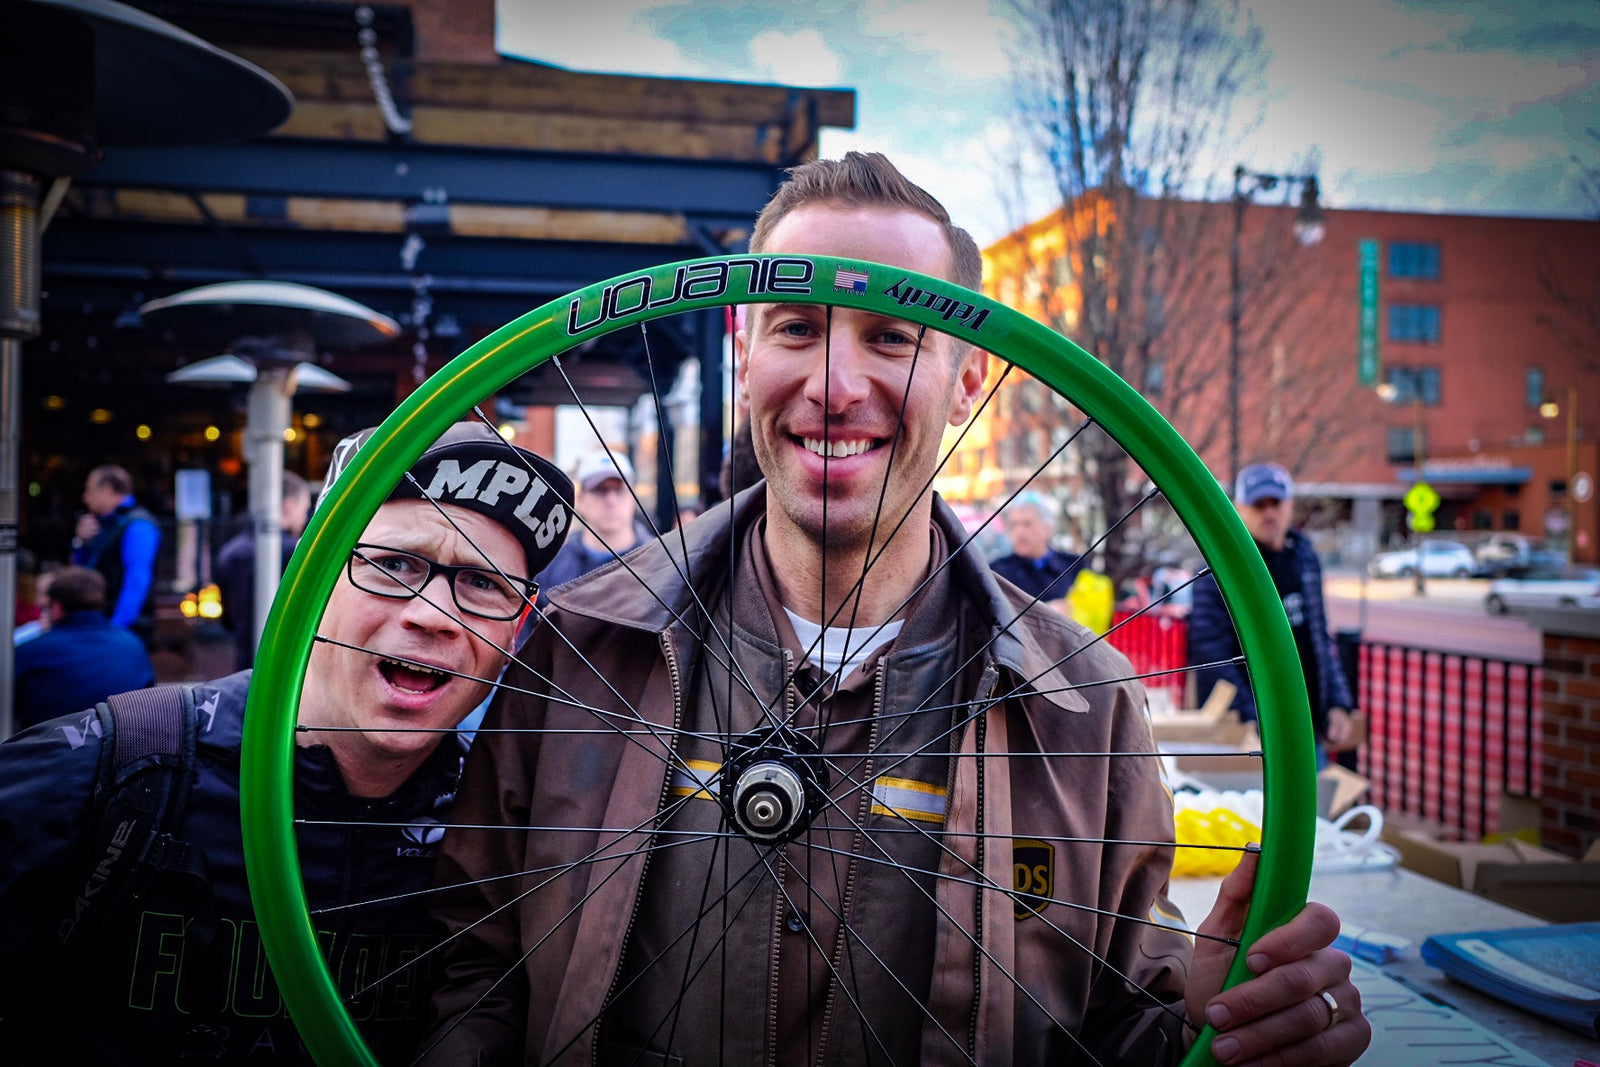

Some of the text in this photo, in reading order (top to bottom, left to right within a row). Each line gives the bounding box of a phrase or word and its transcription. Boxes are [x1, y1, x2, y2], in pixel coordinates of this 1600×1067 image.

[883, 277, 992, 332] Velocity
[421, 459, 567, 549] MPLS
[57, 819, 137, 945] DAKINE
